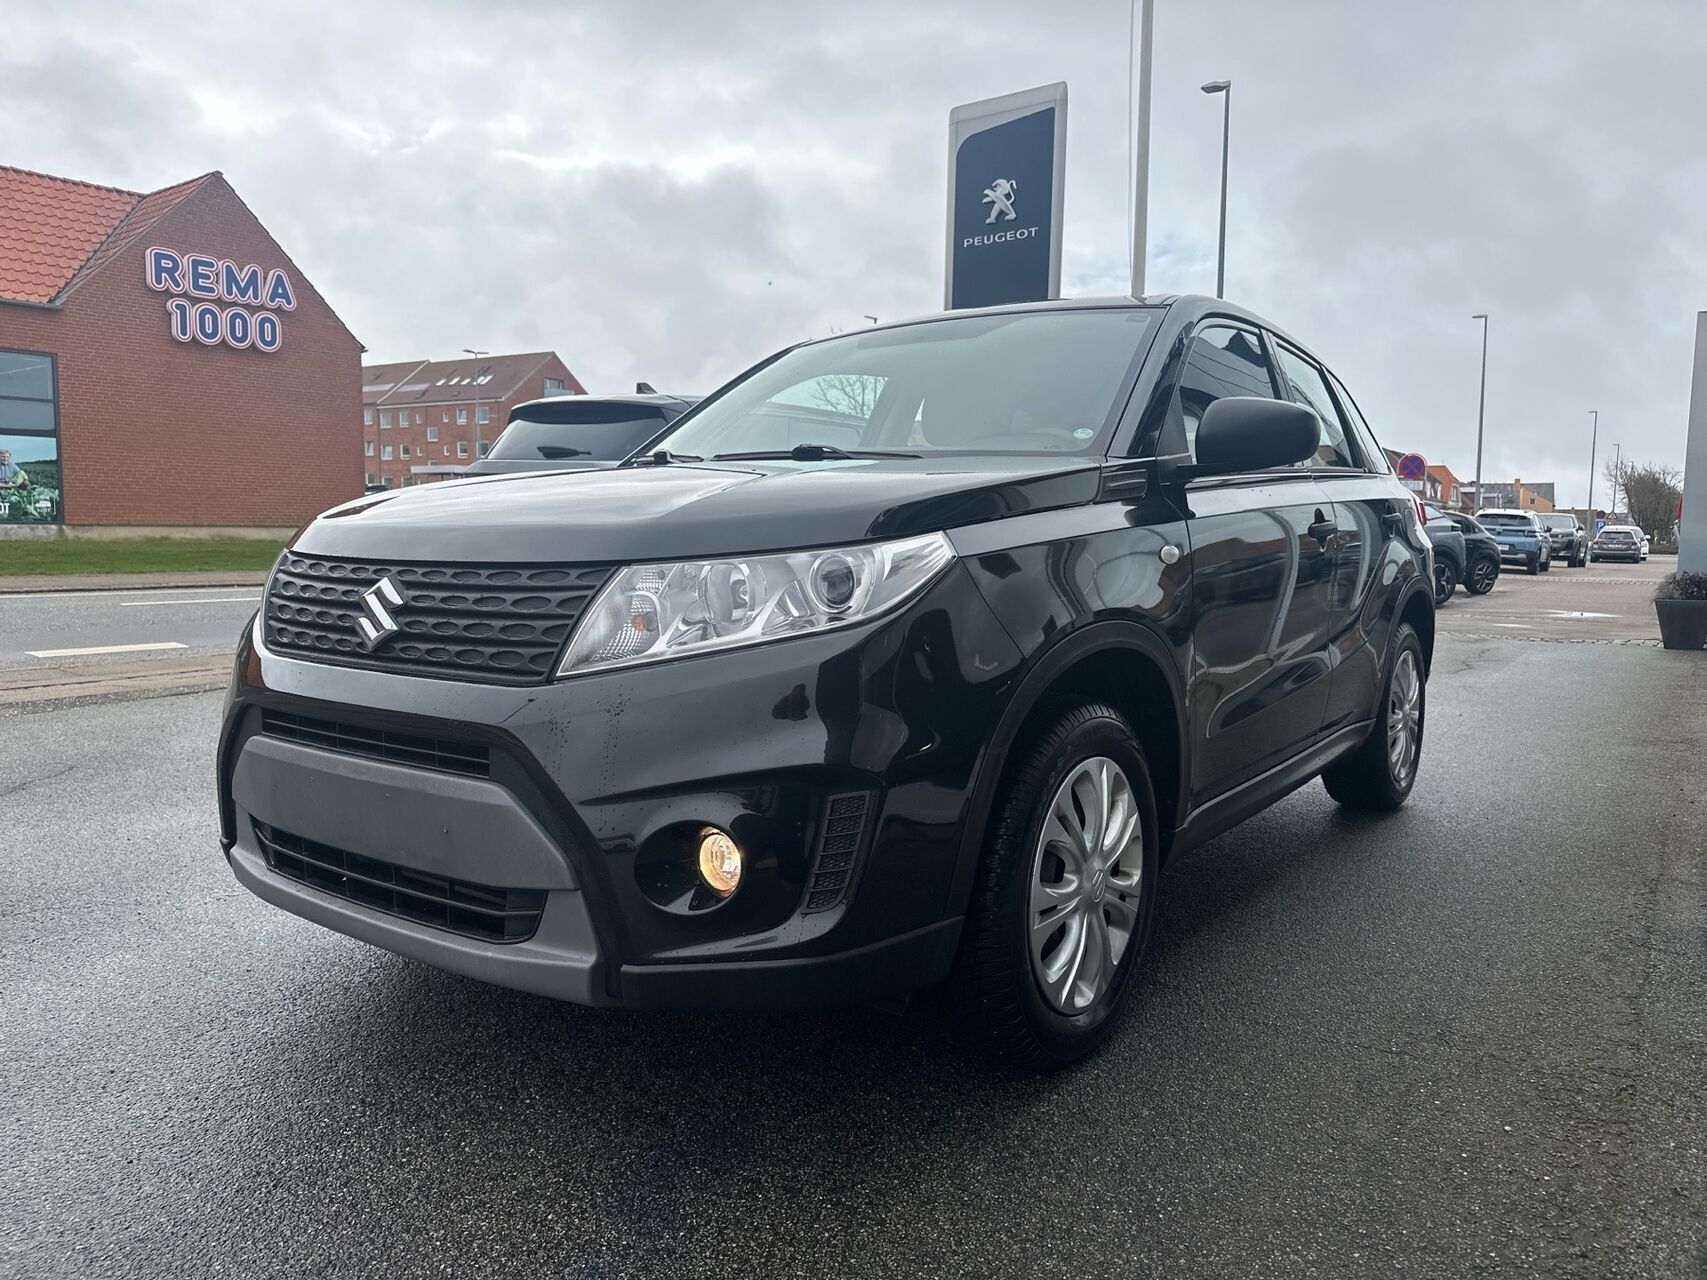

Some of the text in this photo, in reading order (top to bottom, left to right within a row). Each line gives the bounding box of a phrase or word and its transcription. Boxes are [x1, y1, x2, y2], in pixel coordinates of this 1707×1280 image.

[963, 227, 1039, 248] PEUGEOT
[145, 247, 297, 311] REMA
[166, 298, 282, 352] 1000
